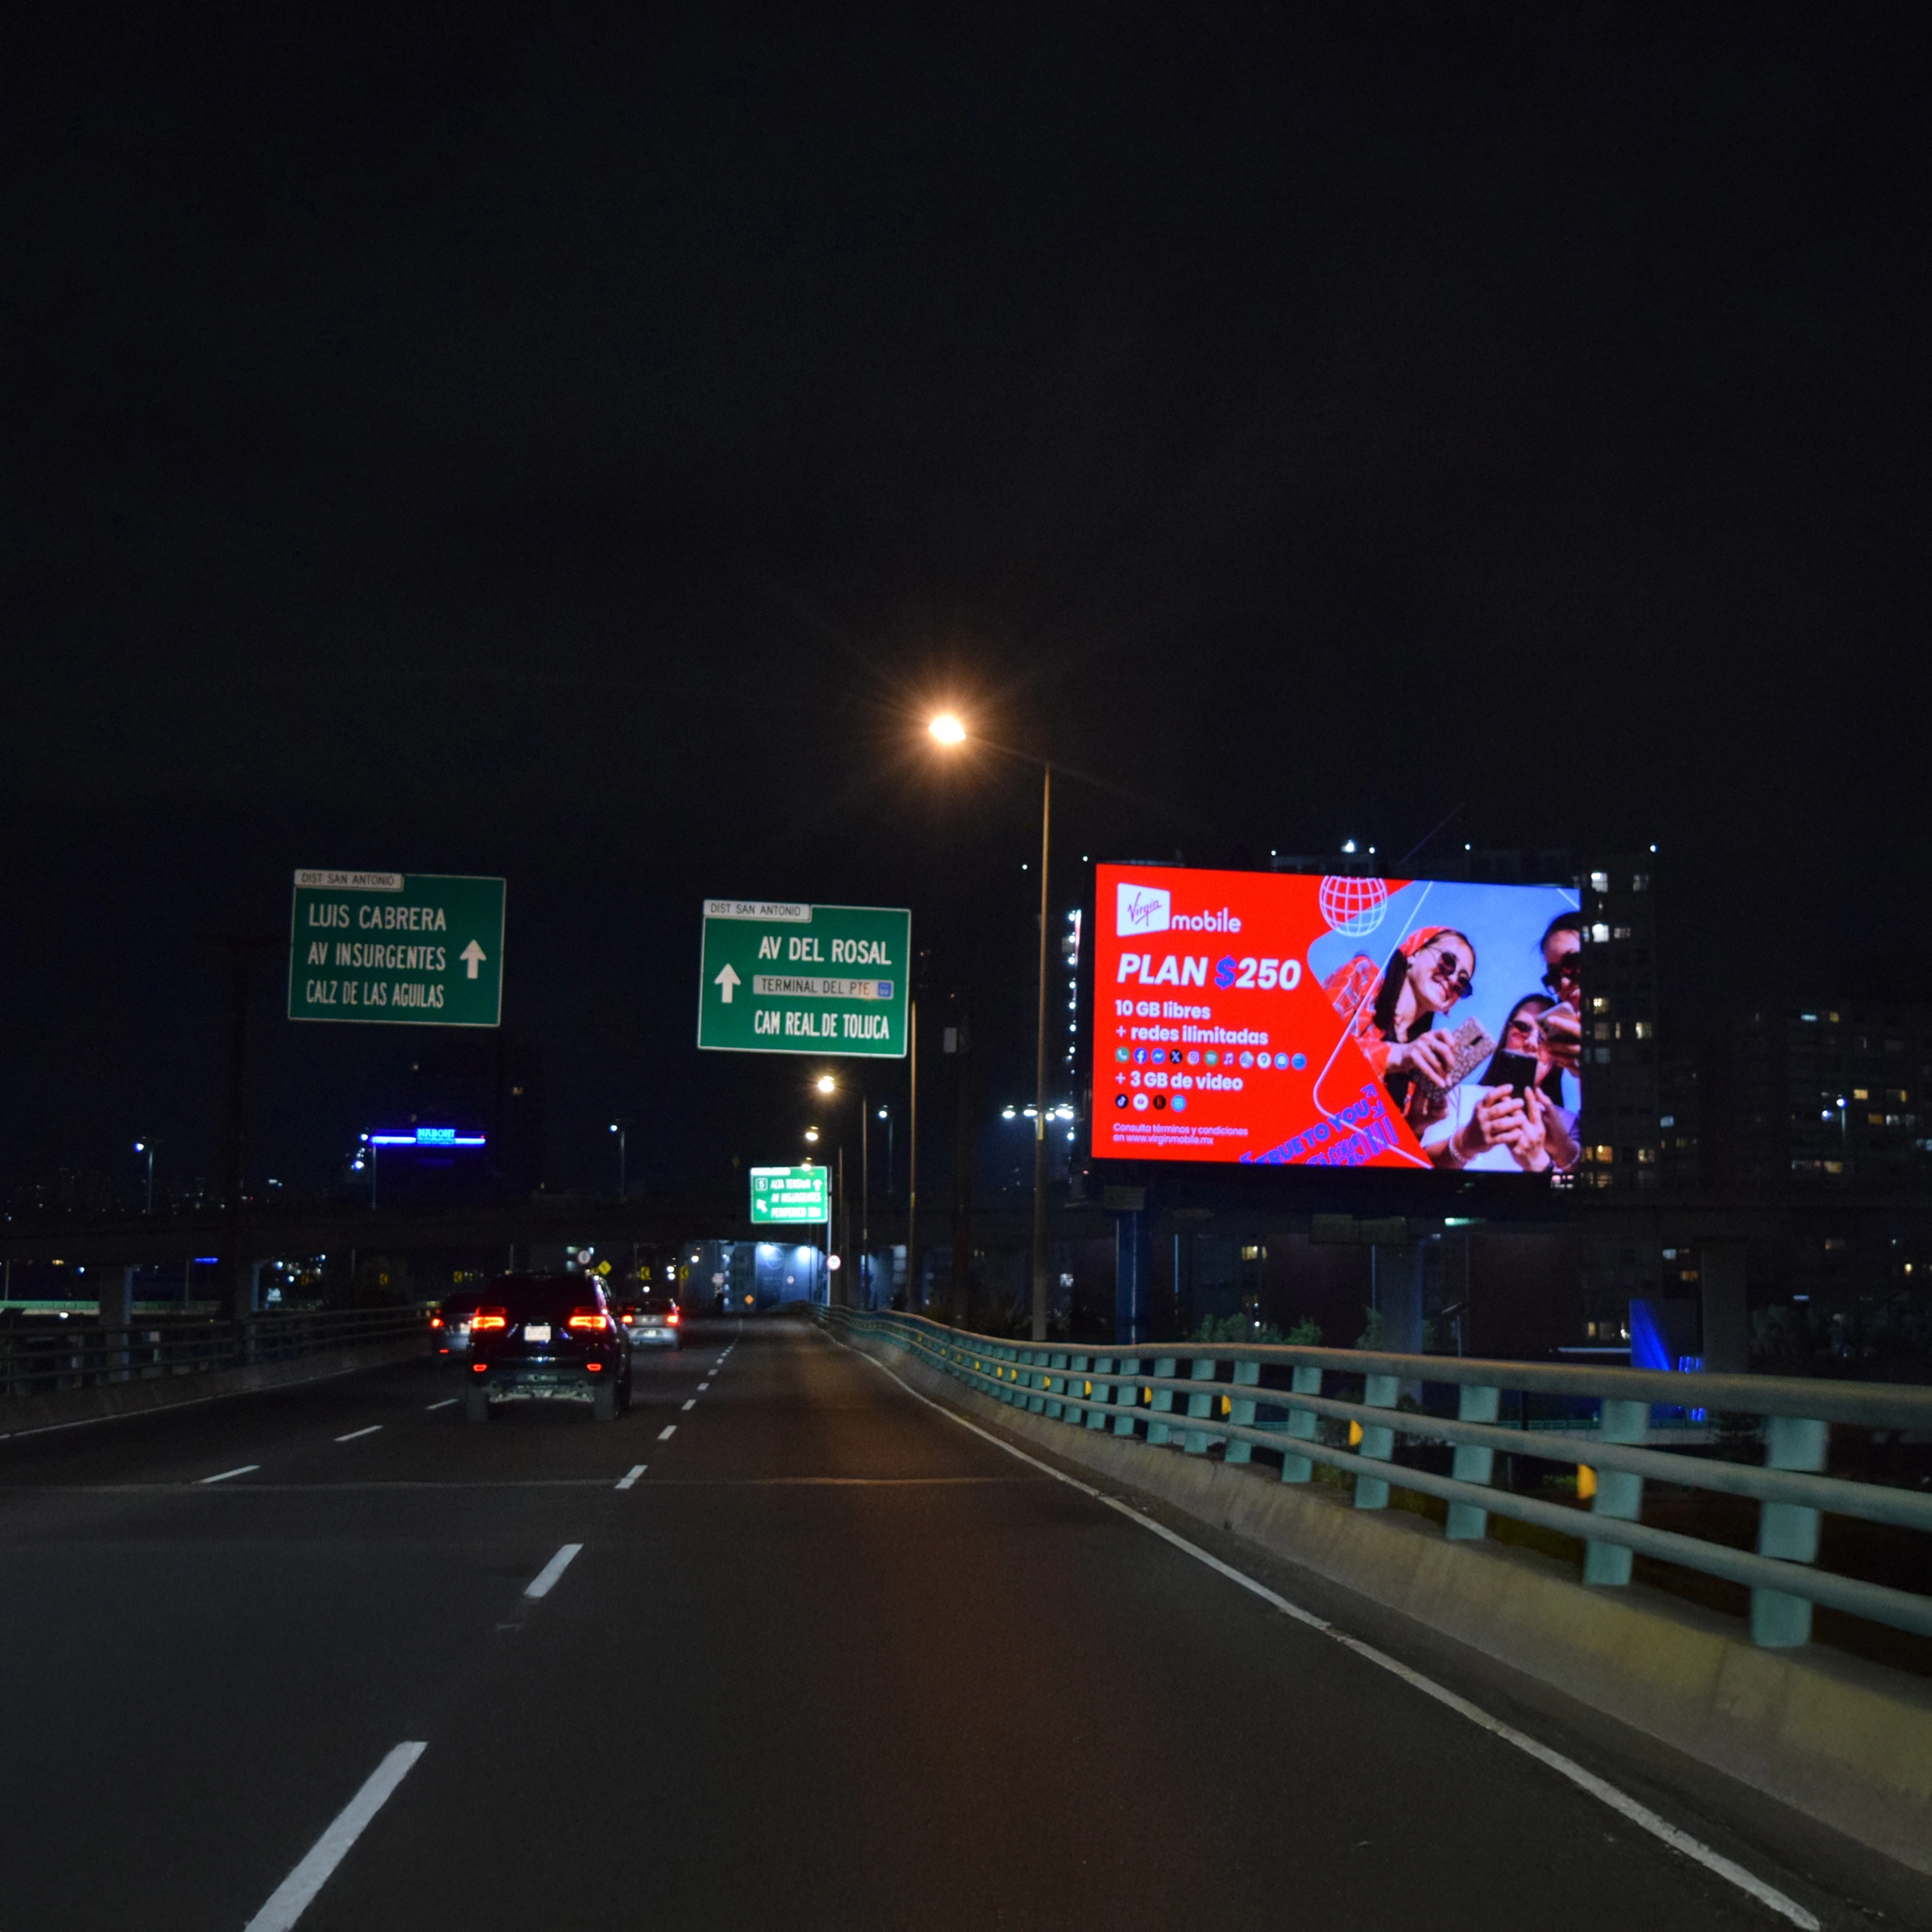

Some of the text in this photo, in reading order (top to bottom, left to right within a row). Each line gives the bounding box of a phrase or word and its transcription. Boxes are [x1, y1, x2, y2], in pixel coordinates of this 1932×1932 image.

[302, 872, 394, 886] DIST SAN ANTONIO
[309, 903, 447, 932] LUIS CABRERA
[711, 903, 801, 917] DIST SAN ANTONIO
[1128, 892, 1162, 927] Virgin
[1171, 907, 1241, 934] mobile
[307, 942, 446, 971] AV INSURGENTES
[758, 936, 892, 965] AV DEL ROSAL
[1117, 952, 1301, 991] PLAN $250
[306, 980, 445, 1009] CALZ DE LAS AGUILAS
[762, 978, 870, 995] TERMINAL DEL PTE
[1115, 999, 1211, 1020] 10 GB libres
[754, 1010, 890, 1040] CAM REAL DE TOLUCA
[1115, 1025, 1269, 1046] + redes ilimitadas
[1115, 1070, 1244, 1091] + 3 GB de video
[1113, 1122, 1152, 1133] Consulta
[1191, 1126, 1198, 1136] y
[1198, 1124, 1249, 1137] condiciones
[1301, 1122, 1330, 1148] TO
[1327, 1098, 1370, 1132] YOU
[1113, 1134, 1124, 1142] en
